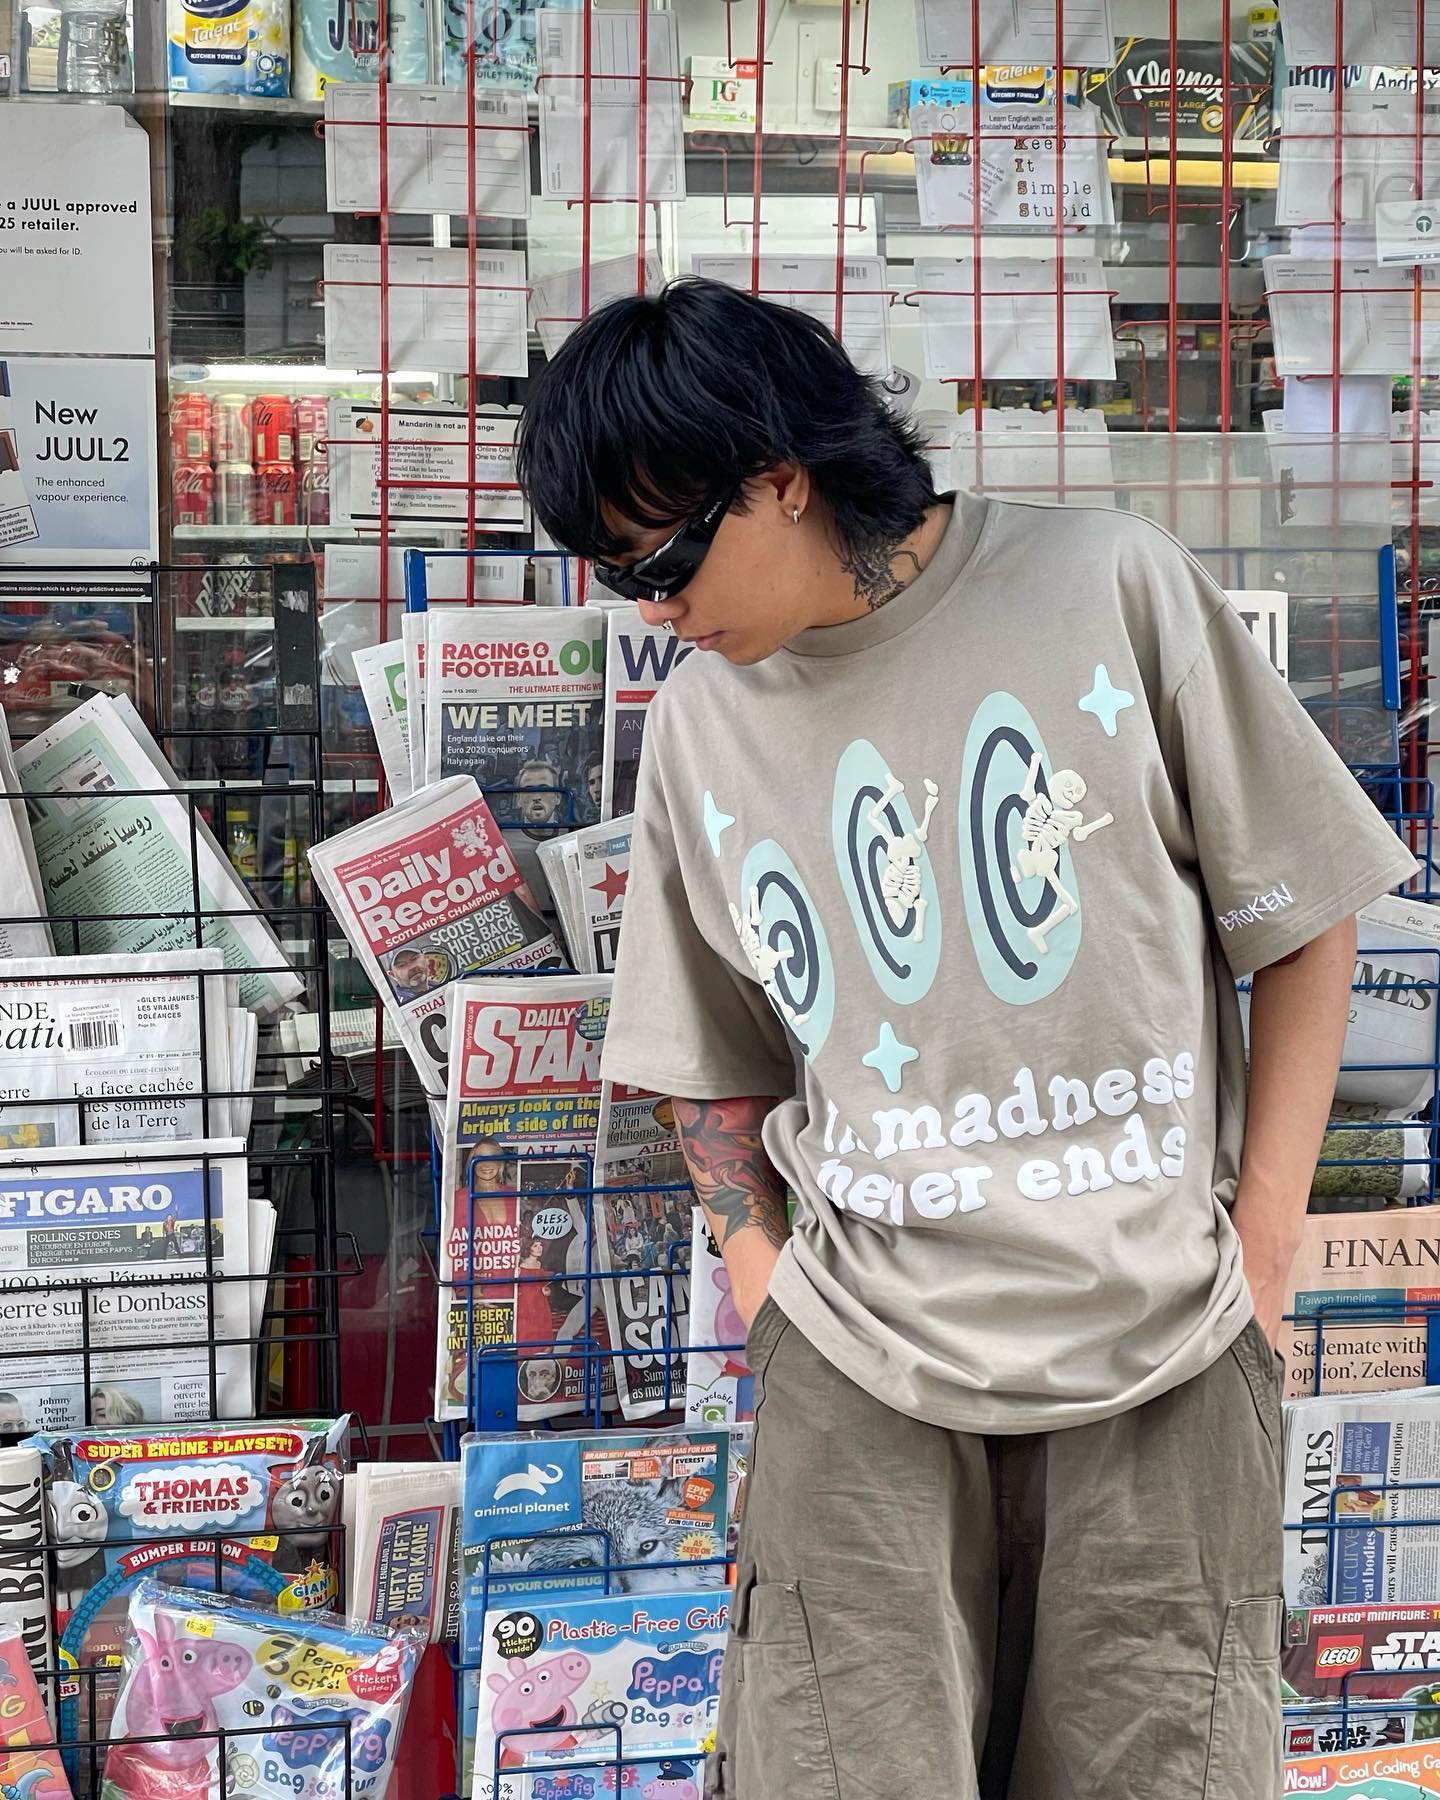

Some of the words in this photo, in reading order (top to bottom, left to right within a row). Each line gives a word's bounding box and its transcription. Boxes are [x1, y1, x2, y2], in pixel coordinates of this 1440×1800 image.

[191, 20, 241, 43] Talent
[1127, 61, 1239, 102] Kleenex
[1149, 100, 1177, 108] EXTR
[1179, 101, 1206, 109] LARGE
[1008, 115, 1031, 123] English
[7, 202, 15, 210] a
[22, 198, 60, 211] JUUL
[66, 201, 137, 215] approved
[35, 400, 98, 425] New
[35, 437, 129, 462] JUUL2
[36, 477, 53, 487] The
[57, 477, 105, 487] enhanced
[36, 494, 70, 504] vapour
[73, 493, 128, 504] experience.
[442, 643, 529, 659] RACING
[442, 660, 558, 678] FOOTBALL
[448, 705, 498, 729] WE
[508, 704, 591, 728] MEET
[447, 734, 477, 744] England
[479, 735, 495, 743] take
[508, 734, 524, 742] their
[447, 746, 464, 754] Euro
[466, 746, 485, 754] 2020
[487, 746, 529, 755] conquerors
[447, 757, 463, 766] Italy
[464, 758, 485, 766] again
[345, 847, 451, 912] Daily
[360, 845, 517, 943] Record
[1218, 882, 1294, 934] BROKEN
[386, 914, 446, 947] SCOTLAND'S
[448, 888, 500, 918] CHAMPION
[430, 917, 474, 946] SCOTS
[475, 900, 511, 928] BOSS
[448, 933, 480, 955] HITS
[480, 914, 518, 940] BACK
[457, 953, 474, 969] AT
[473, 928, 524, 960] CRITICS
[524, 1007, 578, 1028] DAILY
[466, 1006, 602, 1090] STAR
[74, 1082, 93, 1096] La
[101, 1081, 134, 1095] face
[139, 1078, 194, 1093] cachée
[462, 1102, 516, 1118] Always
[519, 1099, 553, 1112] look
[555, 1100, 574, 1110] on
[577, 1098, 600, 1109] the
[612, 1104, 652, 1118] Summer
[871, 1052, 1196, 1161] madness
[92, 1117, 110, 1130] de
[117, 1115, 130, 1128] la
[136, 1114, 178, 1128] Terre
[462, 1119, 511, 1137] bright
[516, 1117, 548, 1132] side
[553, 1116, 569, 1130] of
[573, 1113, 598, 1128] life
[611, 1119, 621, 1130] of
[624, 1118, 640, 1129] fun
[610, 1130, 624, 1142] (at
[627, 1126, 659, 1140] home)
[1016, 1112, 1187, 1201] ends
[536, 1214, 568, 1224] BLESS
[30, 1233, 77, 1243] ROLLING
[78, 1230, 121, 1241] STONES
[541, 1226, 563, 1236] YOU
[449, 1242, 469, 1257] UP
[473, 1239, 521, 1255] YOURS
[1298, 1295, 1334, 1306] Taiwan
[1336, 1293, 1377, 1304] timeline
[1383, 1337, 1427, 1354] with
[173, 1382, 203, 1392] Guerre
[173, 1391, 206, 1400] ouverte
[39, 1397, 71, 1407] Johnny
[44, 1406, 68, 1416] Depp
[174, 1400, 196, 1409] entre
[690, 1391, 734, 1413] Recyclable
[46, 1414, 76, 1423] Amber
[88, 1442, 144, 1459] SUPER
[147, 1440, 208, 1457] ENGINE
[212, 1434, 293, 1453] PLAYSET!
[1391, 1423, 1404, 1476] disruption
[584, 1473, 614, 1481] BUBBLES!
[134, 1476, 250, 1501] THOMAS
[687, 1484, 711, 1497] EPIC
[1301, 1430, 1334, 1555] TIMES
[474, 1503, 524, 1518] animal
[525, 1502, 570, 1517] planet
[1389, 1493, 1399, 1519] week
[393, 1520, 412, 1563] FIFTY
[410, 1522, 429, 1567] KANE
[129, 1542, 184, 1568] BUMPER
[190, 1540, 242, 1560] EDITON
[1386, 1554, 1396, 1574] will
[388, 1566, 408, 1612] NIFTY
[407, 1571, 425, 1603] FOR
[1313, 1613, 1335, 1624] EPIC
[1367, 1610, 1430, 1622] MINIFIGURE:
[498, 1617, 536, 1638] 90
[502, 1637, 537, 1648] stickers
[505, 1644, 533, 1654] inside!
[1318, 1647, 1361, 1666] LEGO
[352, 1672, 398, 1684] stickers
[635, 1661, 704, 1702] Peppa
[356, 1682, 395, 1694] inside!
[631, 1705, 670, 1727] Bag
[1292, 1734, 1312, 1745] LEGO
[534, 1777, 572, 1797] Peppa
[574, 1776, 593, 1796] Pig
[1283, 1766, 1328, 1791] Now!
